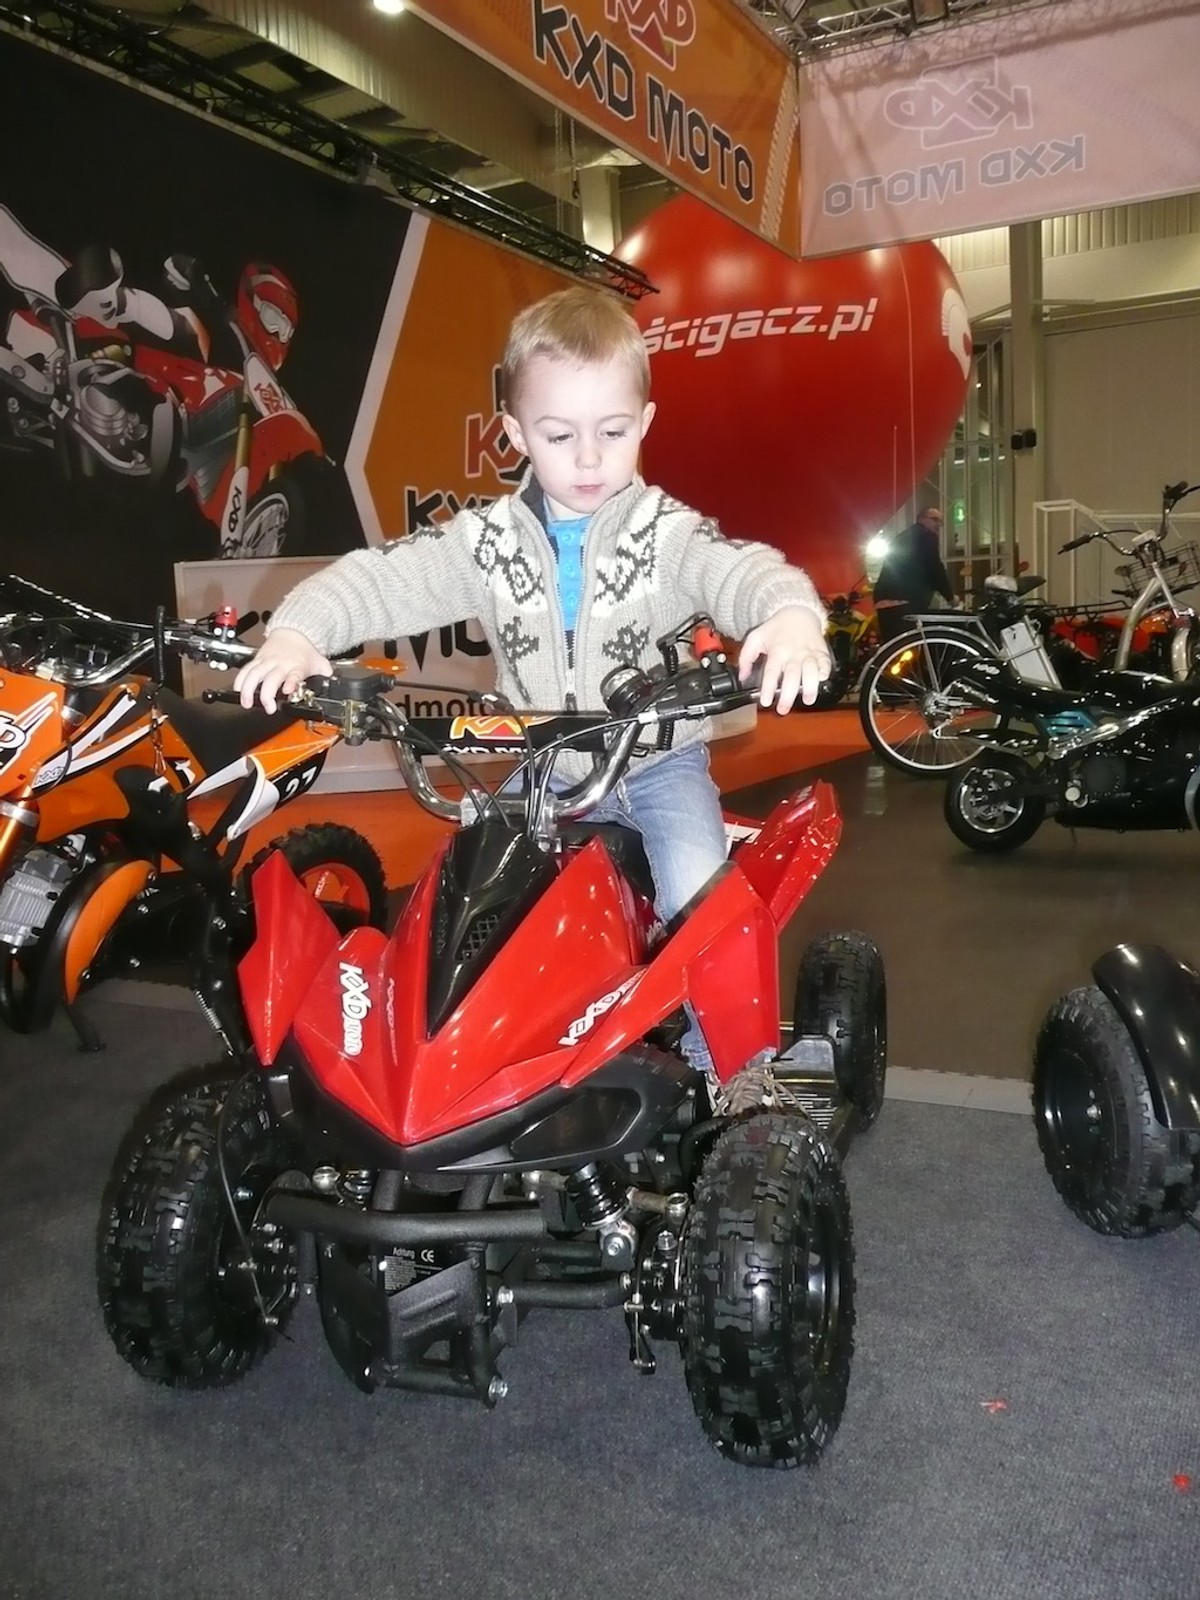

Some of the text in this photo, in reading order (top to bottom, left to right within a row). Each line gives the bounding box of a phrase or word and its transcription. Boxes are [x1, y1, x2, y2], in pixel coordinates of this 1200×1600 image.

[531, 0, 755, 204] KXD MOTO
[642, 297, 879, 358] ścigacz.pl
[339, 962, 372, 1020] KXD
[557, 990, 622, 1046] KXD
